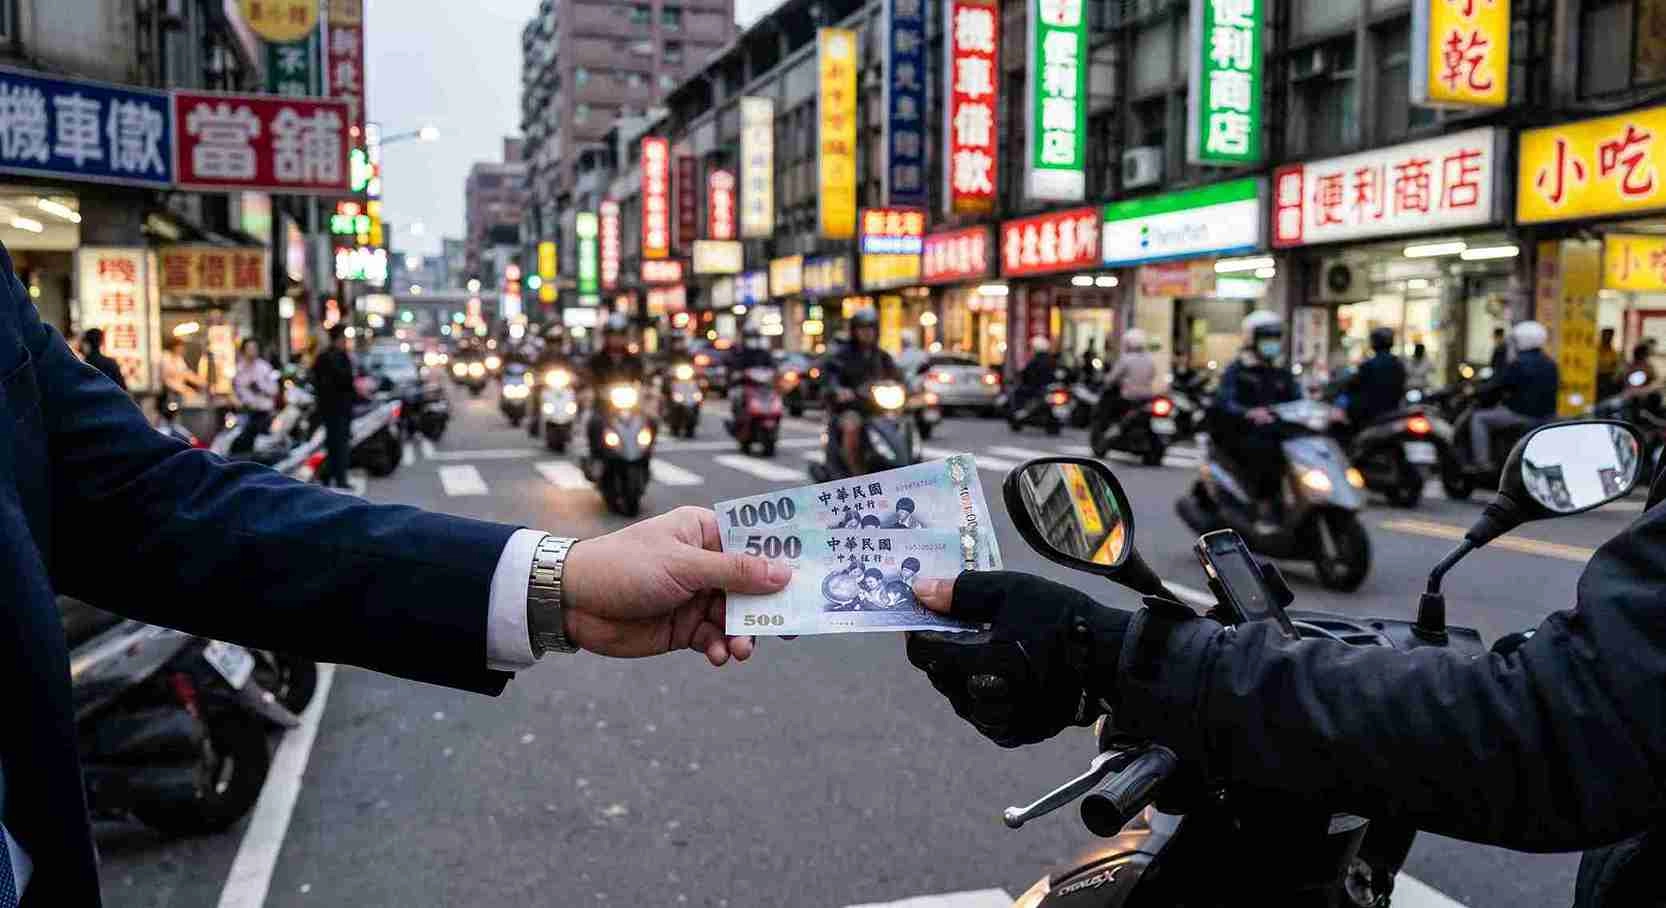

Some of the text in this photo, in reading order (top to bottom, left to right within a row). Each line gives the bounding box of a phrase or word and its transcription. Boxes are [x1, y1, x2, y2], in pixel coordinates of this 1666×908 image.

[1537, 125, 1655, 204] 小吃
[1313, 148, 1483, 226] 便利商店
[819, 482, 882, 506] 中華民國
[726, 497, 796, 528] 1000
[744, 535, 802, 559] 500
[826, 536, 892, 552] 中華民國
[743, 614, 784, 626] 500
